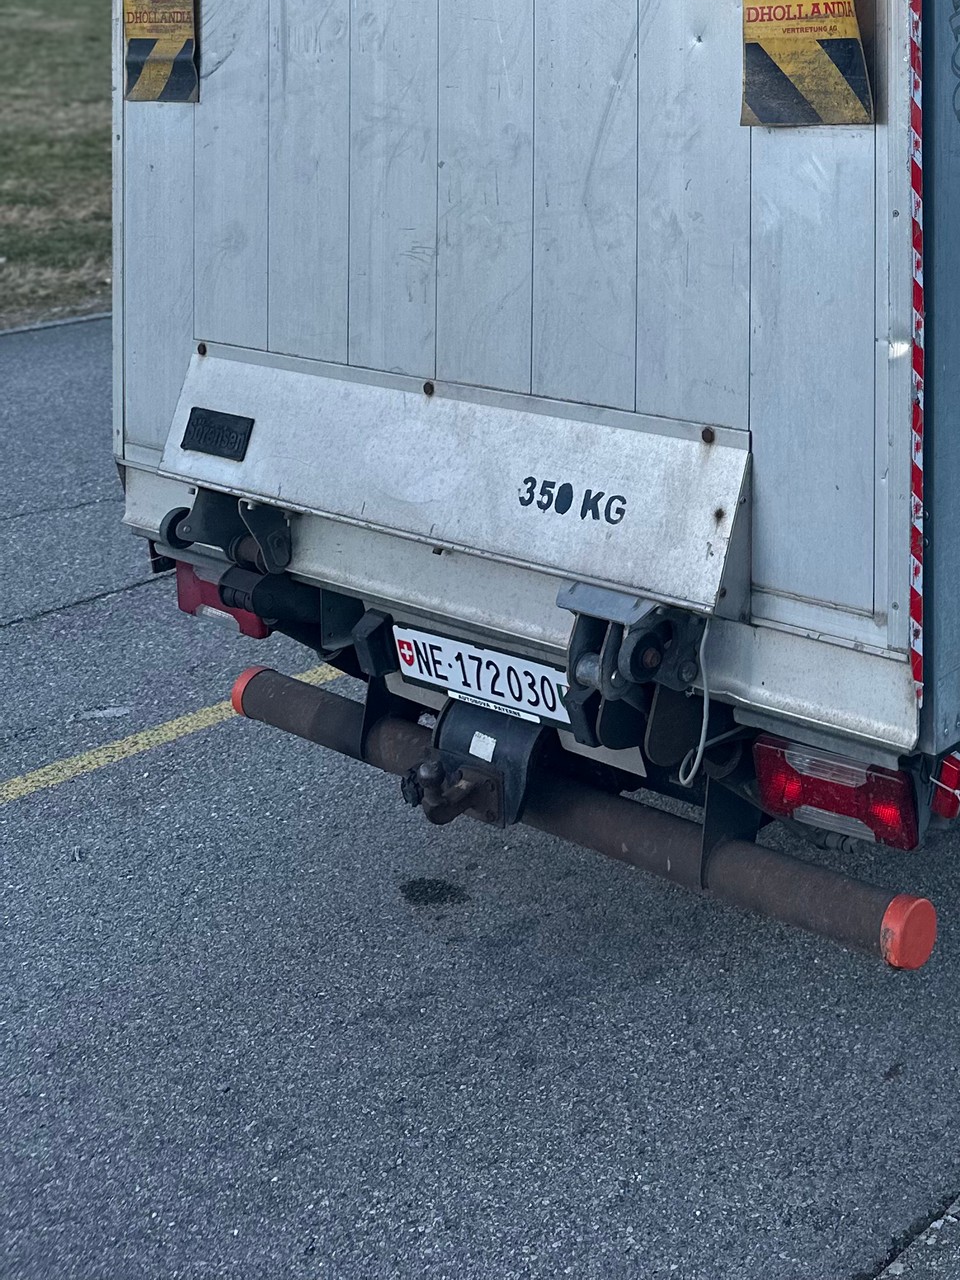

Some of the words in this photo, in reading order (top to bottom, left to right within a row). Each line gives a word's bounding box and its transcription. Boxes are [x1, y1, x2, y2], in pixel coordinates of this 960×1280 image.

[127, 10, 193, 24] DHOLLANDIA
[746, 1, 855, 23] DHOLLANDIA
[781, 26, 828, 34] VERTRETUNG
[518, 476, 574, 515] 350
[580, 489, 627, 525] KG
